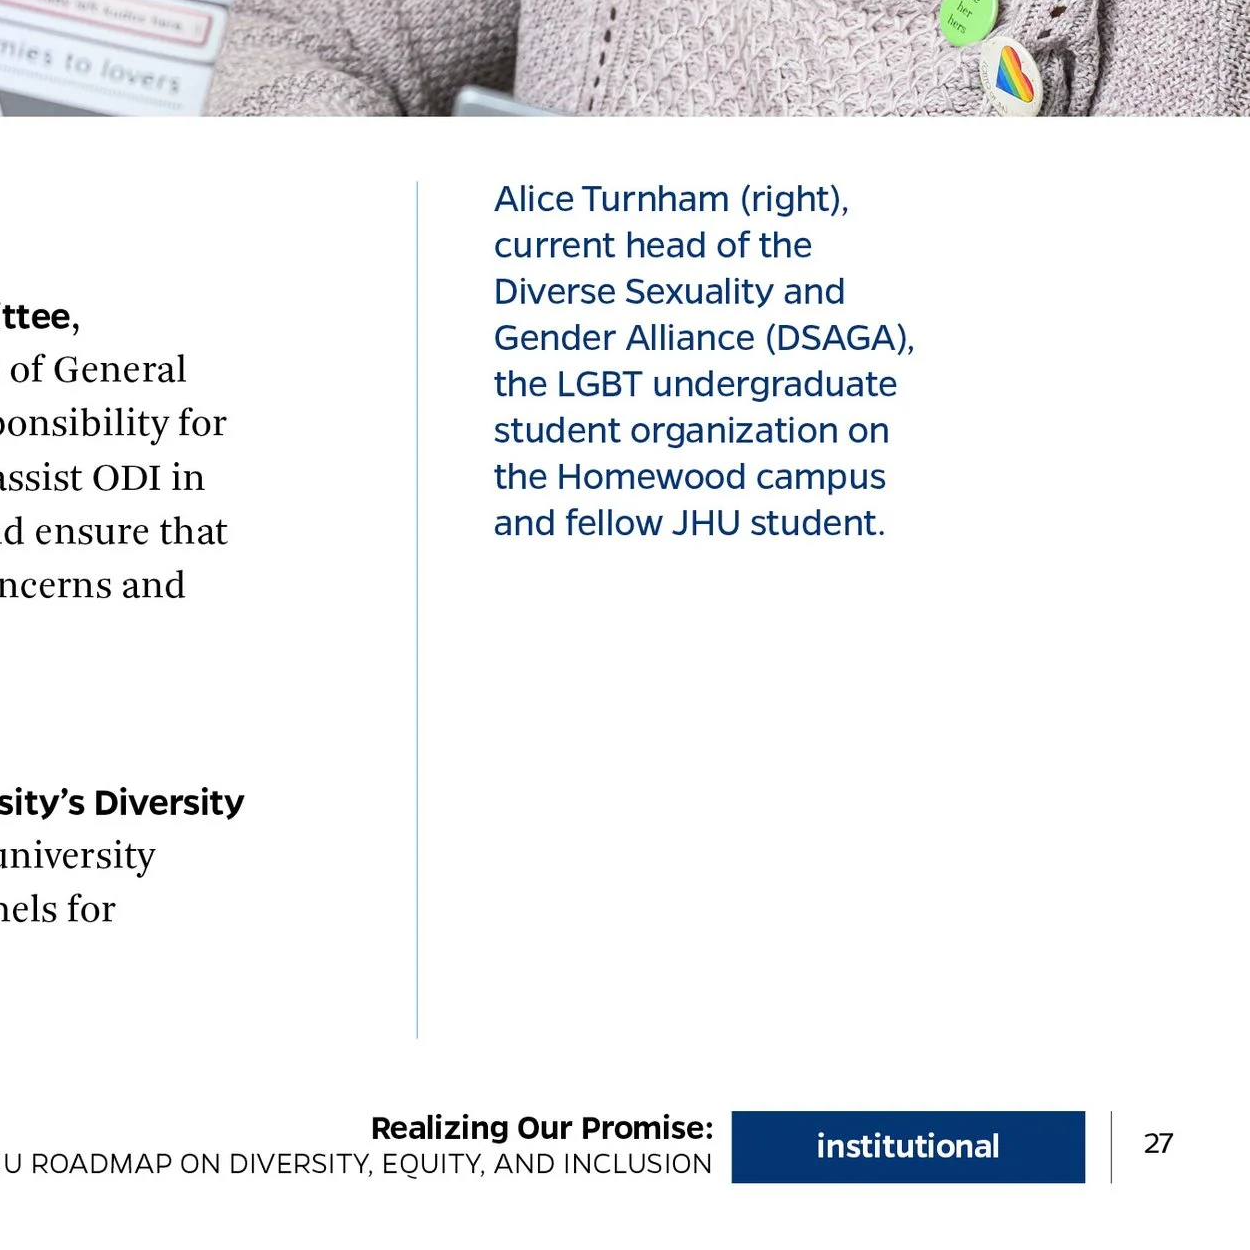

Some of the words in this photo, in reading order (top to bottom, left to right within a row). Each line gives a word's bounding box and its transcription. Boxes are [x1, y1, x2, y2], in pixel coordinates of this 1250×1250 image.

[947, 14, 967, 35] hers
[956, 1, 972, 19] her
[65, 52, 92, 75] to
[102, 60, 181, 95] lovers
[494, 185, 573, 211] Alice
[582, 185, 728, 211] Turnham
[742, 184, 847, 217] (right),
[495, 233, 615, 258] current
[628, 231, 705, 258] head
[717, 230, 750, 258] of
[759, 231, 811, 258] the
[496, 278, 615, 304] Diverse
[626, 278, 774, 308] Sexuality
[784, 278, 844, 304] and
[495, 324, 616, 350] Gender
[626, 324, 754, 350] Alliance
[767, 323, 913, 355] (DSAGA),
[11, 353, 46, 383] of
[54, 354, 186, 383] General
[494, 370, 546, 397] the
[559, 371, 643, 397] LGBT
[654, 370, 897, 402] undergraduate
[179, 407, 227, 436] for
[495, 416, 621, 443] student
[631, 417, 837, 448] organization
[849, 423, 888, 443] on
[93, 465, 160, 491] ODI
[172, 462, 205, 490] in
[494, 463, 546, 489] the
[559, 463, 745, 489] Homewood
[757, 469, 885, 495] campus
[36, 525, 148, 545] ensure
[160, 516, 228, 545] that
[495, 509, 554, 535] and
[566, 508, 663, 535] fellow
[672, 510, 739, 535] JHU
[751, 509, 884, 535] student.
[123, 570, 185, 598] and
[96, 787, 245, 820] Diversity
[68, 893, 116, 922] for
[373, 1114, 508, 1144] Realizing
[518, 1116, 573, 1139] Our
[583, 1114, 712, 1139] Promise:
[1145, 1133, 1173, 1153] 27
[817, 1131, 1000, 1159] institutional
[33, 1153, 171, 1173] ROADMAP
[181, 1153, 219, 1173] ON
[231, 1153, 372, 1177] DIVERSITY,
[384, 1153, 484, 1179] EQUITY,
[494, 1153, 554, 1173] AND
[566, 1153, 710, 1173] INCLUSION
